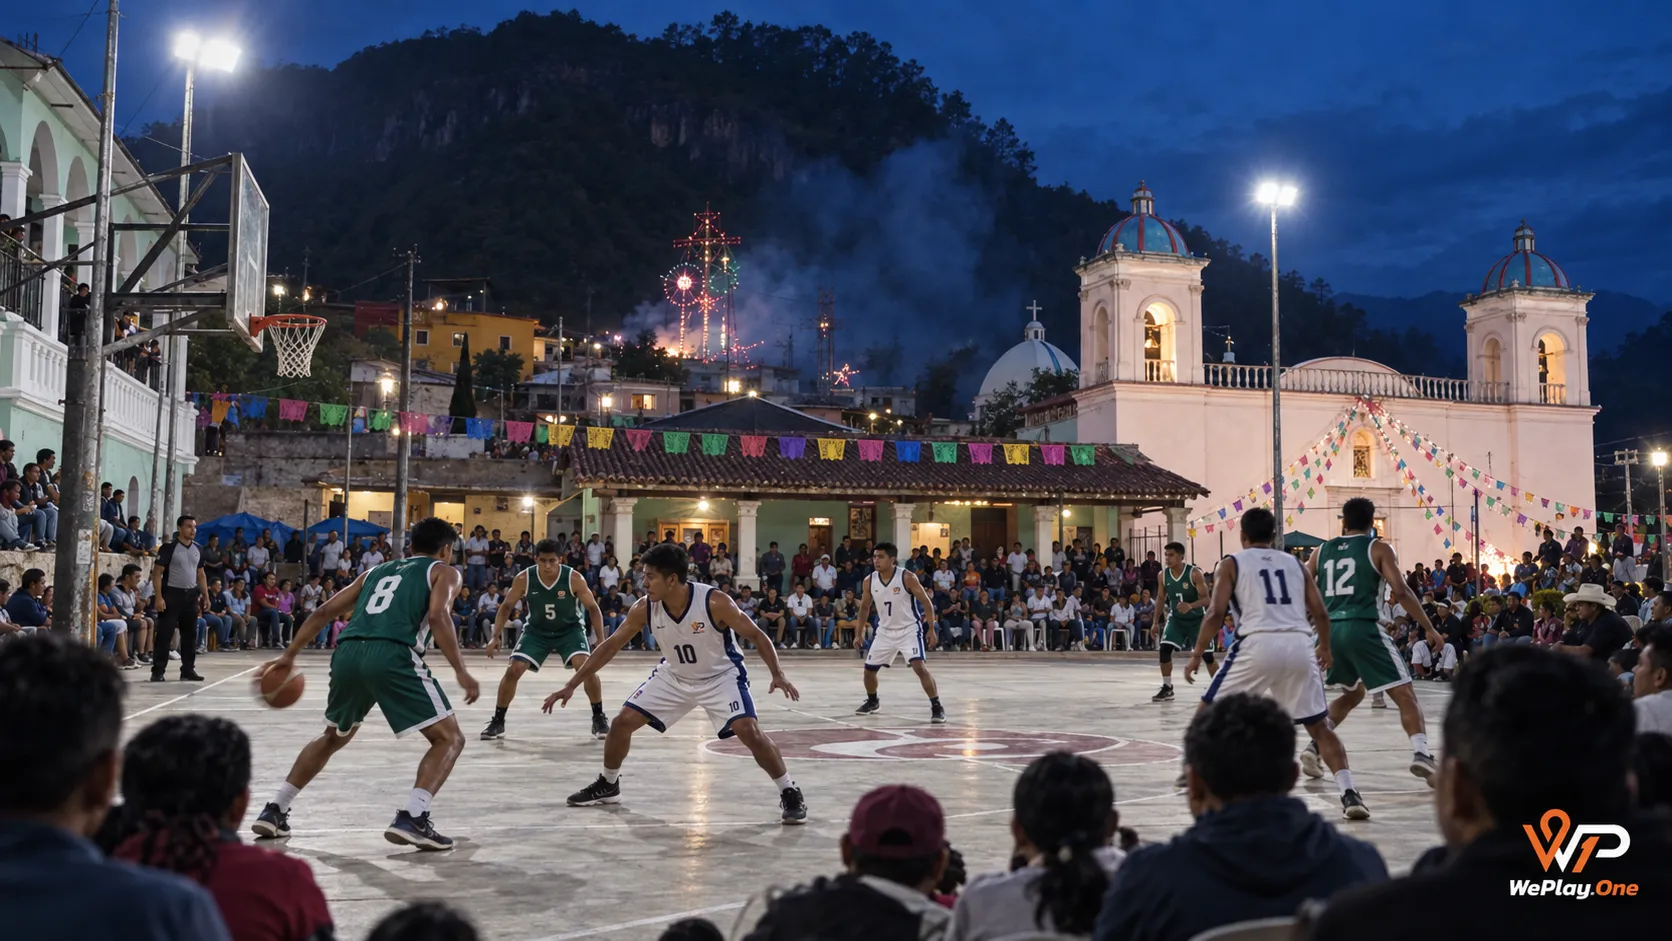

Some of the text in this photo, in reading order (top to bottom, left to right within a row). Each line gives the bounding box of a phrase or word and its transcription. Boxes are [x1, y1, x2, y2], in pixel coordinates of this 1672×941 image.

[1259, 569, 1292, 605] 11
[1323, 557, 1356, 597] 12
[365, 574, 403, 615] 8
[544, 603, 557, 620] 5
[883, 601, 892, 617] 7
[673, 643, 698, 664] 10
[728, 700, 740, 713] 10
